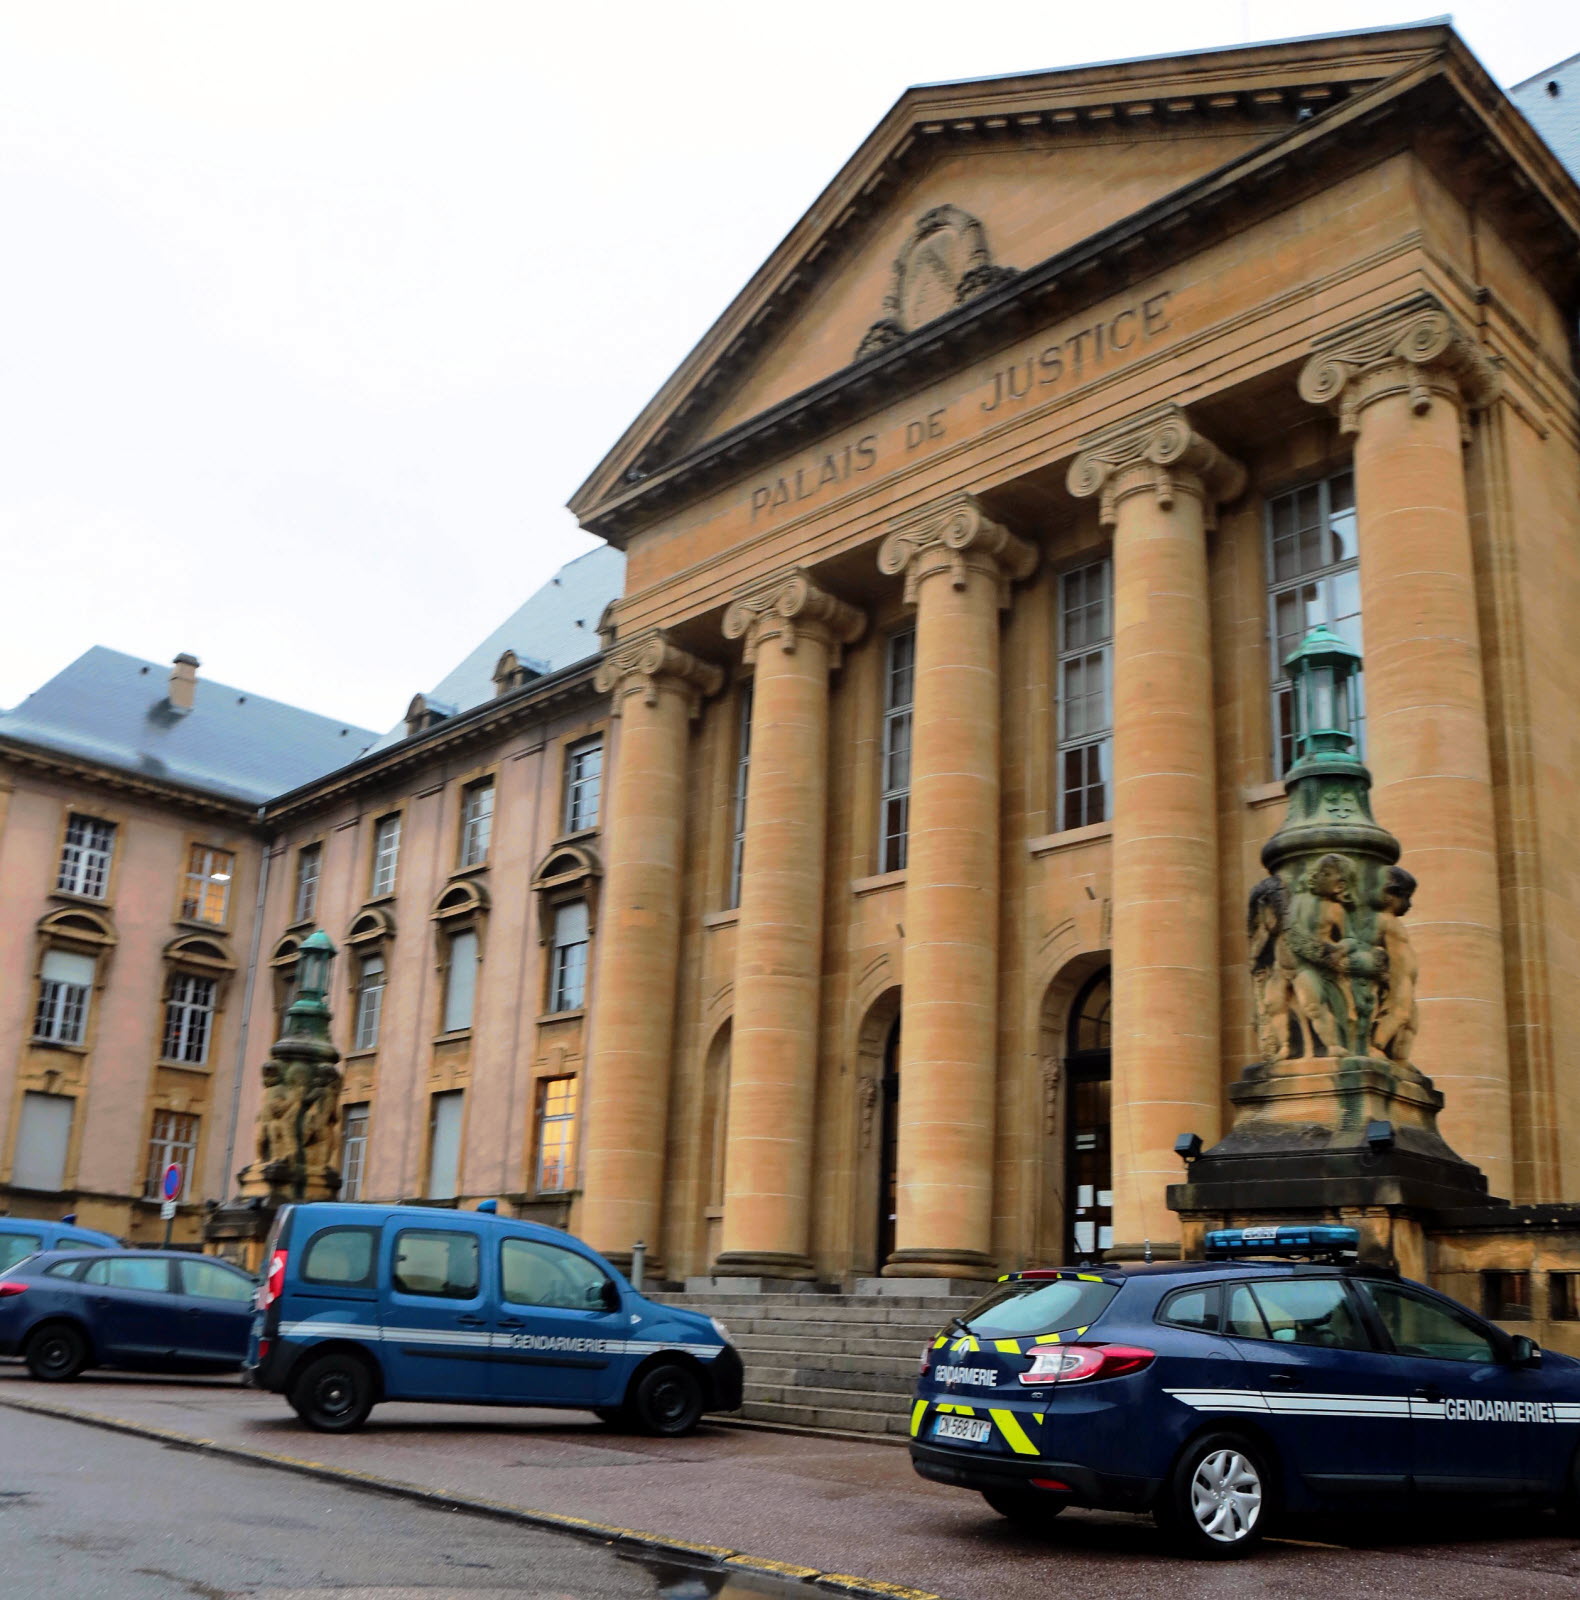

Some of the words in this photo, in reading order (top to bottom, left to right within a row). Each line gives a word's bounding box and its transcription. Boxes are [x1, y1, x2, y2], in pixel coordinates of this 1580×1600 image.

[750, 434, 877, 523] PALAIS
[906, 408, 946, 449] DE
[980, 290, 1170, 412] JUSTICE
[511, 1334, 606, 1352] GENDARMERIE
[935, 1365, 998, 1387] GENDARMERIE
[1445, 1398, 1549, 1422] GENDARMERIE
